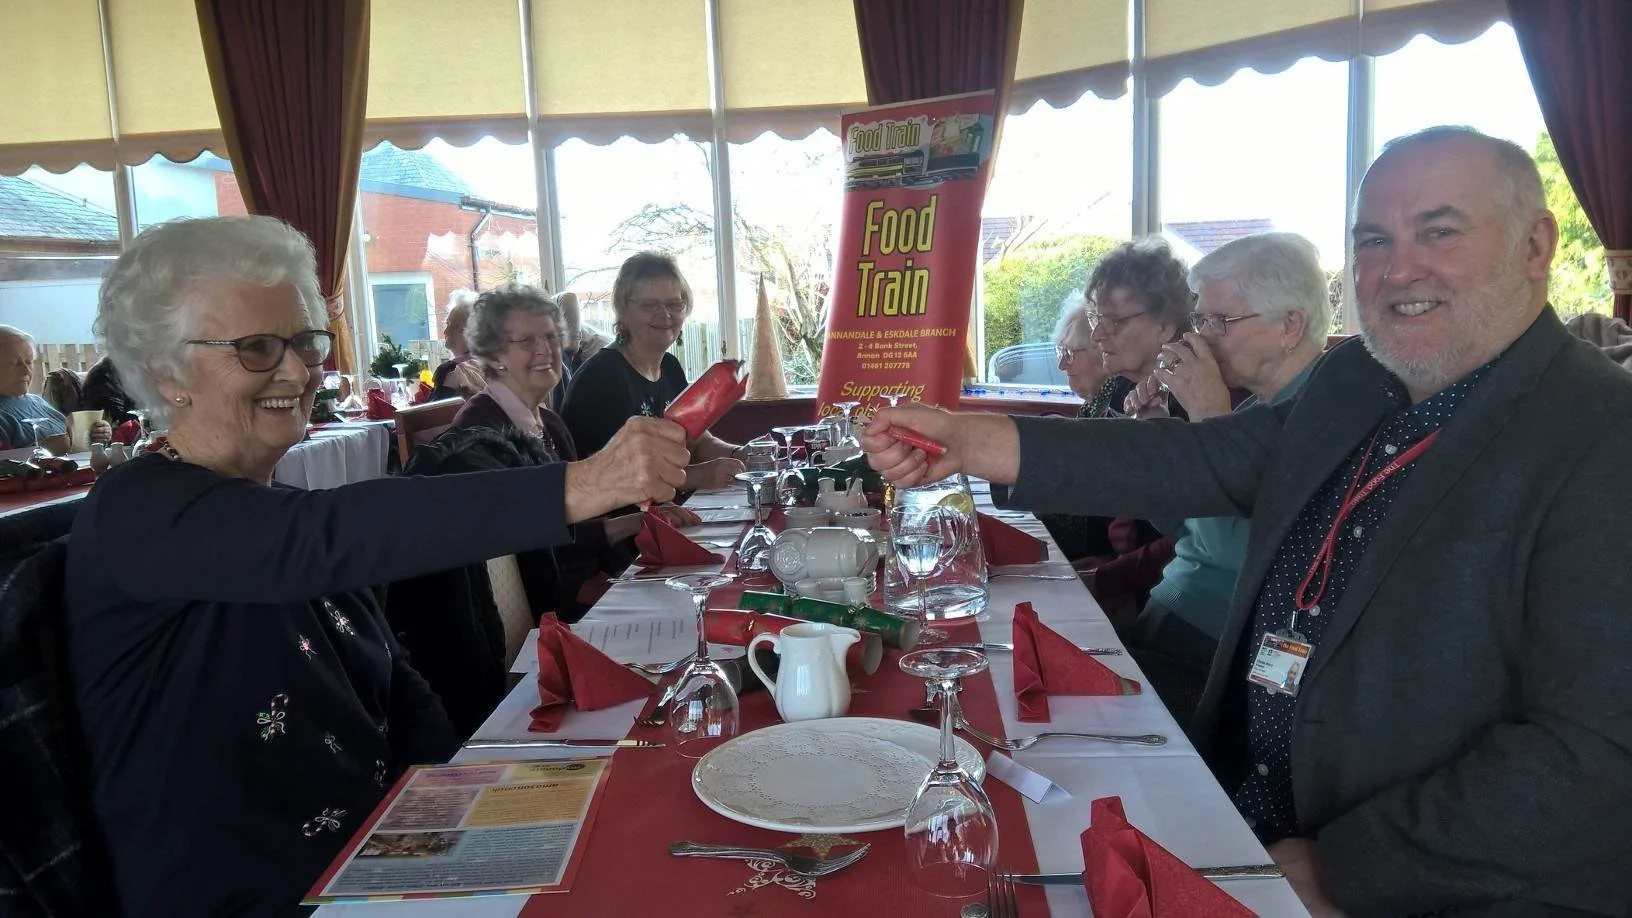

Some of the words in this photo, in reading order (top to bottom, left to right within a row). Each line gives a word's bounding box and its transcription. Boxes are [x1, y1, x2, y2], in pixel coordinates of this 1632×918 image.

[850, 124, 882, 154] Food
[885, 119, 921, 149] Train
[862, 194, 938, 257] Food
[857, 258, 930, 317] Train
[876, 330, 883, 339] &
[884, 329, 919, 339] ESKDALE
[920, 328, 956, 338] BRANCH
[840, 381, 926, 402] Supporting
[818, 401, 847, 417] loca
[1368, 474, 1385, 490] Food
